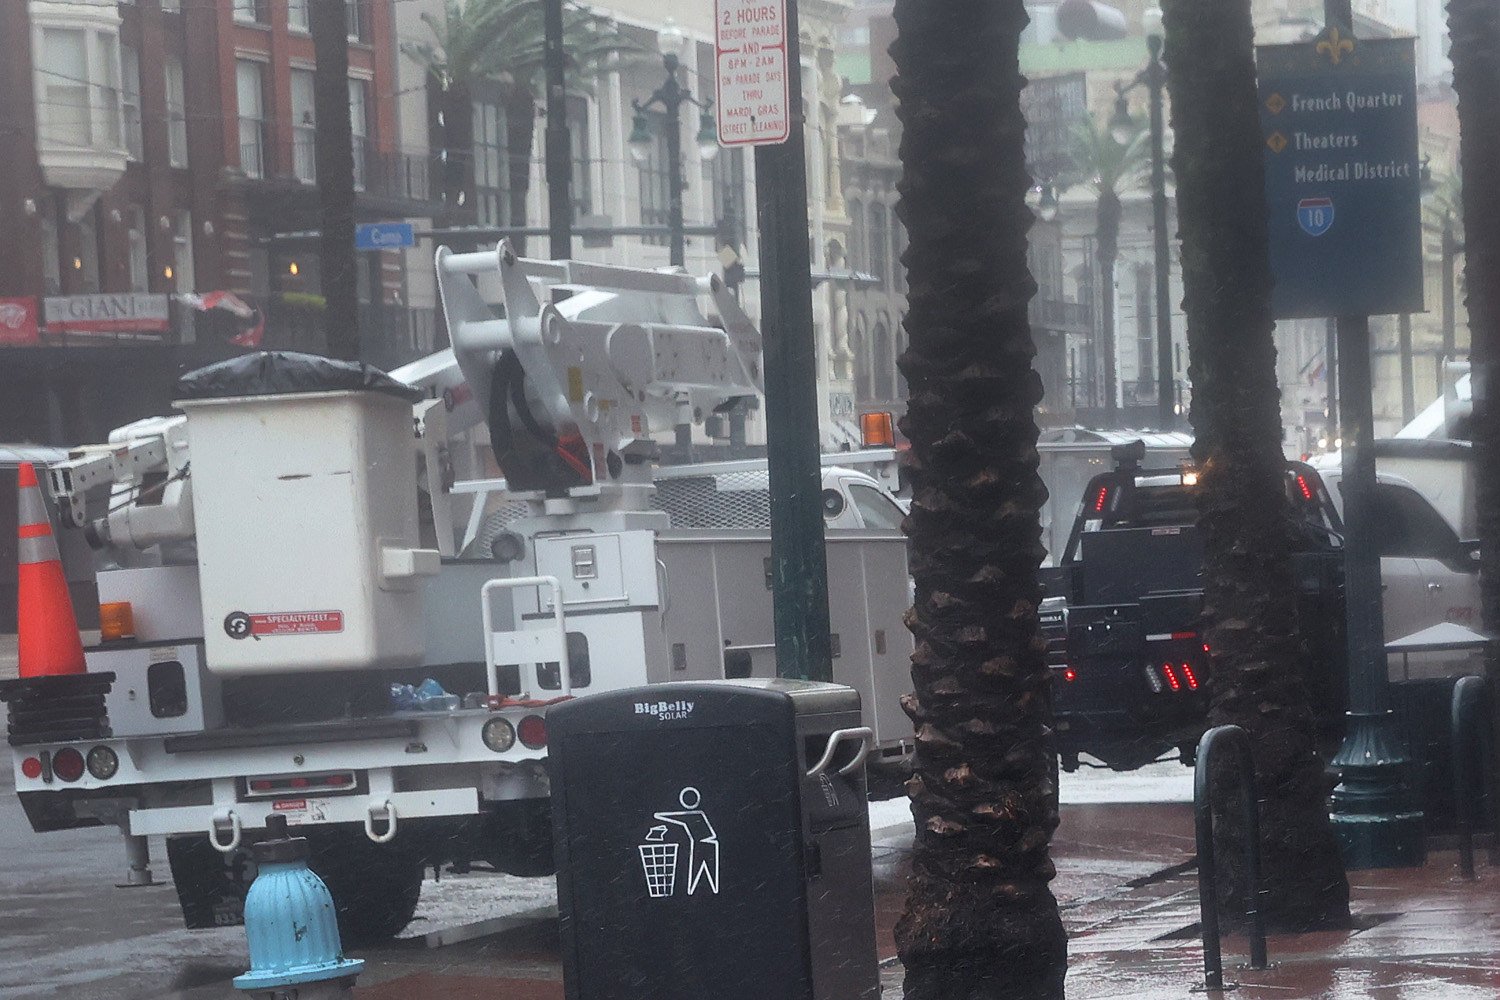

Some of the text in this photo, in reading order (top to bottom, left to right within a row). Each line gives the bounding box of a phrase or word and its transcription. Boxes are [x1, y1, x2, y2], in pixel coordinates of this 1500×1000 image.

[723, 5, 777, 26] 2 HOURS
[720, 24, 780, 40] BEFORE PARADE
[742, 41, 760, 55] AND
[722, 71, 782, 86] ON PARADE DAYS
[742, 89, 763, 101] THRU
[1292, 91, 1403, 112] French Quarter
[726, 104, 779, 118] MARDI GRAS
[1295, 132, 1359, 150] Theaters
[1295, 161, 1410, 183] Medical District
[1308, 208, 1325, 227] 10
[634, 700, 695, 715] BigBelly
[659, 711, 687, 721] SOLAR
